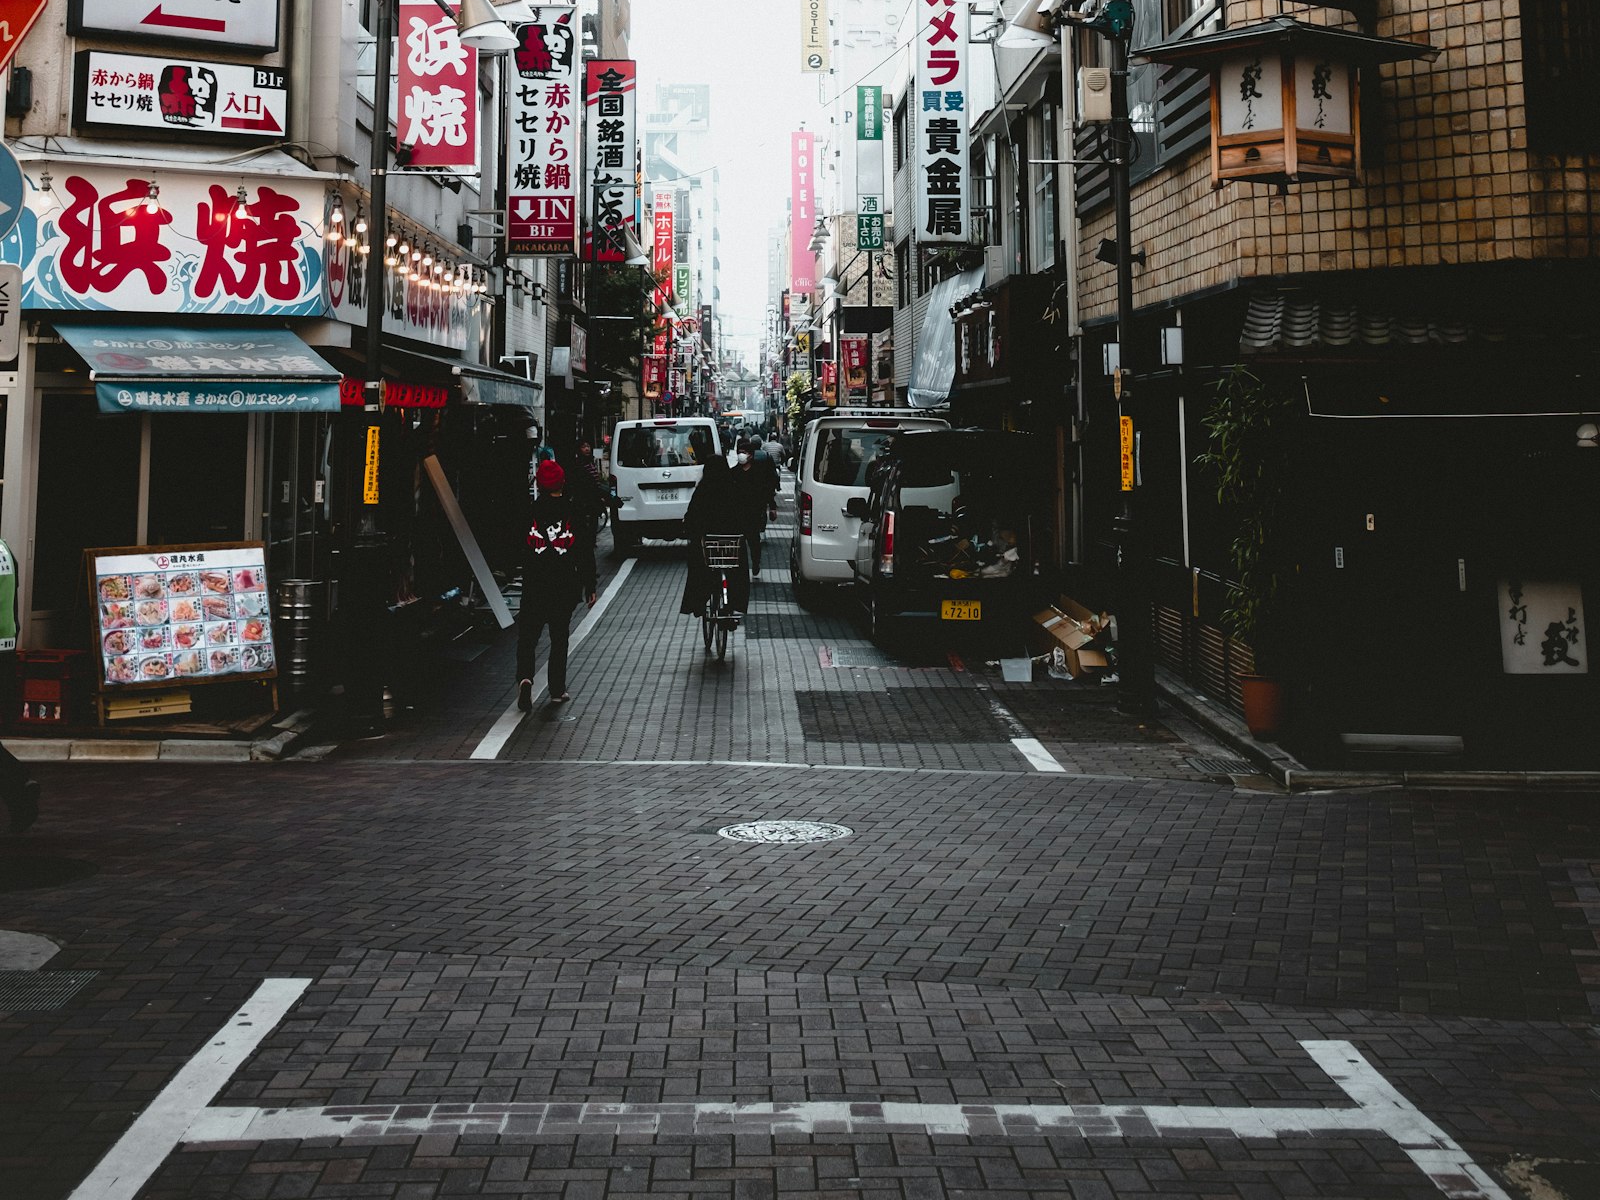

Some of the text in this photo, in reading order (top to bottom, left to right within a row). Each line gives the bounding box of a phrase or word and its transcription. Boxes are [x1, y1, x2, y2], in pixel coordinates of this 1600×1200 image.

[91, 68, 155, 92] 赤から鍋
[256, 70, 285, 88] B1F
[404, 16, 469, 149] 浜焼
[90, 91, 154, 114] セセリ焼
[223, 91, 263, 116] 入口
[922, 90, 966, 112] 買受
[596, 67, 625, 169] 全国銘酒
[514, 83, 541, 191] セセリ焼
[544, 82, 572, 191] 赤から鍋
[798, 137, 808, 220] HOTEL
[925, 117, 964, 237] 貴金属
[537, 197, 573, 221] IN
[862, 196, 878, 213] 酒
[58, 175, 303, 301] 浜焼
[529, 224, 555, 238] B1F
[656, 215, 671, 264] ホテル
[859, 216, 870, 247] 下さい
[871, 216, 881, 247] お売り
[513, 242, 570, 254] AKAKARA
[135, 391, 190, 406] 磯丸水産
[1121, 418, 1130, 480] 客引き行為禁止
[170, 553, 205, 565] 磯丸水産
[950, 607, 979, 618] 72-10
